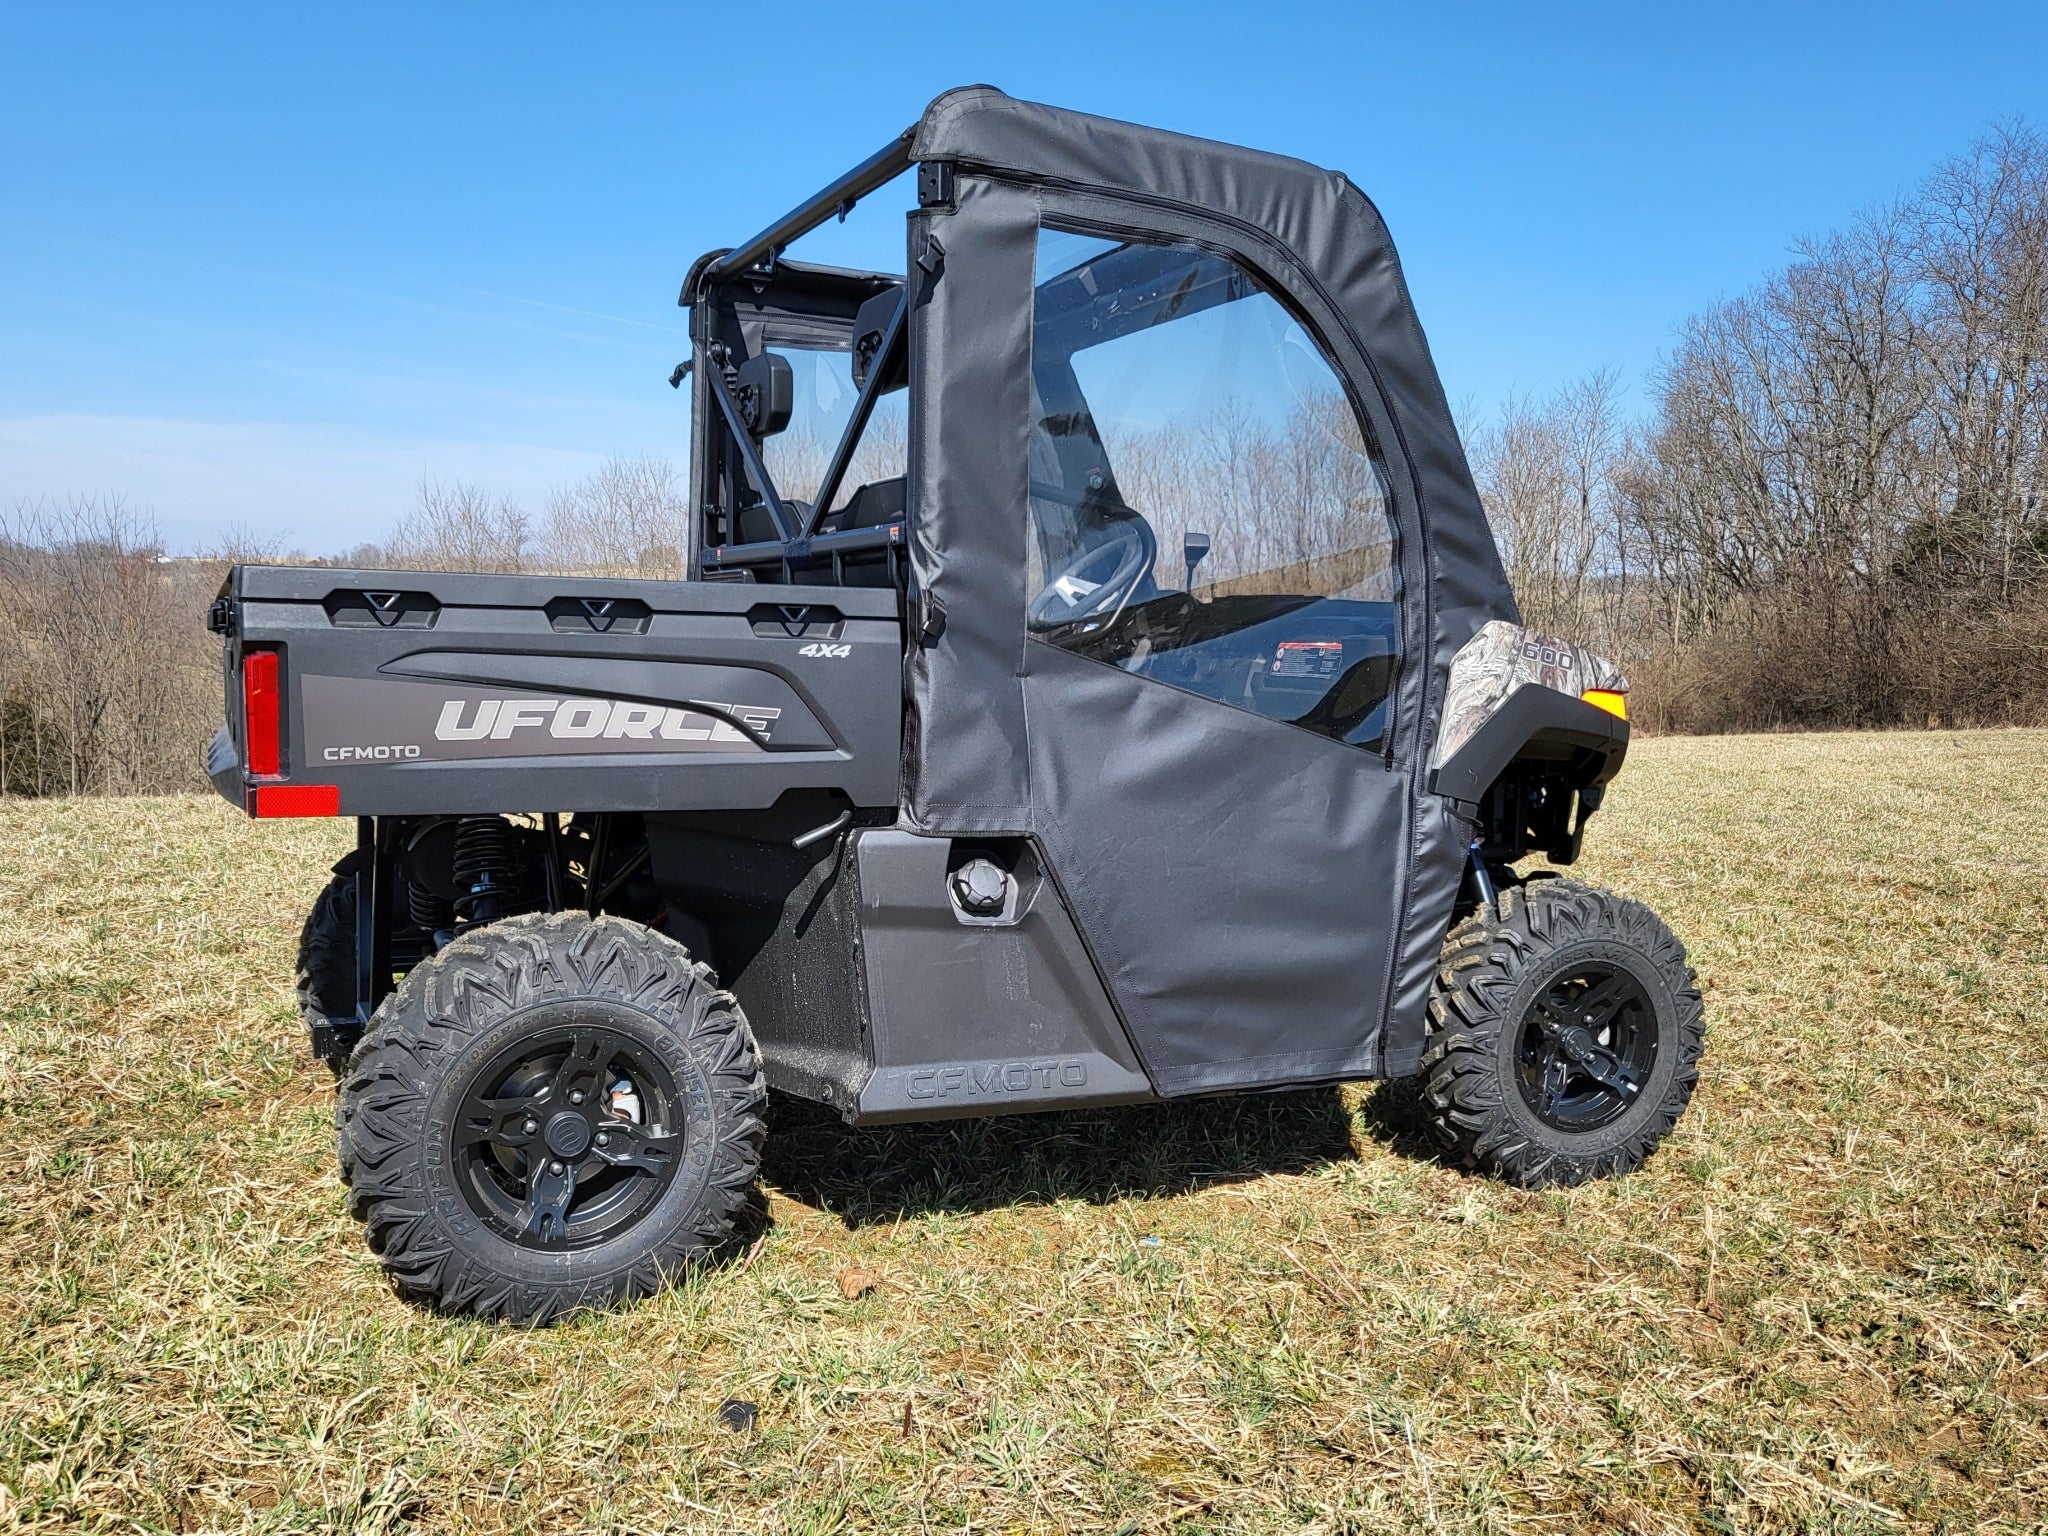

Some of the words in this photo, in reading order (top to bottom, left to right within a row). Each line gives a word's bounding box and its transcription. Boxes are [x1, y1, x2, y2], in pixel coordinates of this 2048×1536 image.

[798, 643, 852, 659] 4X4
[1520, 640, 1574, 672] 600
[434, 698, 782, 742] UFORCE
[323, 744, 420, 760] CFMOTO
[654, 1034, 711, 1125] BRUISER
[906, 1058, 1088, 1100] CFMOTO
[425, 1118, 480, 1236] ARISUN
